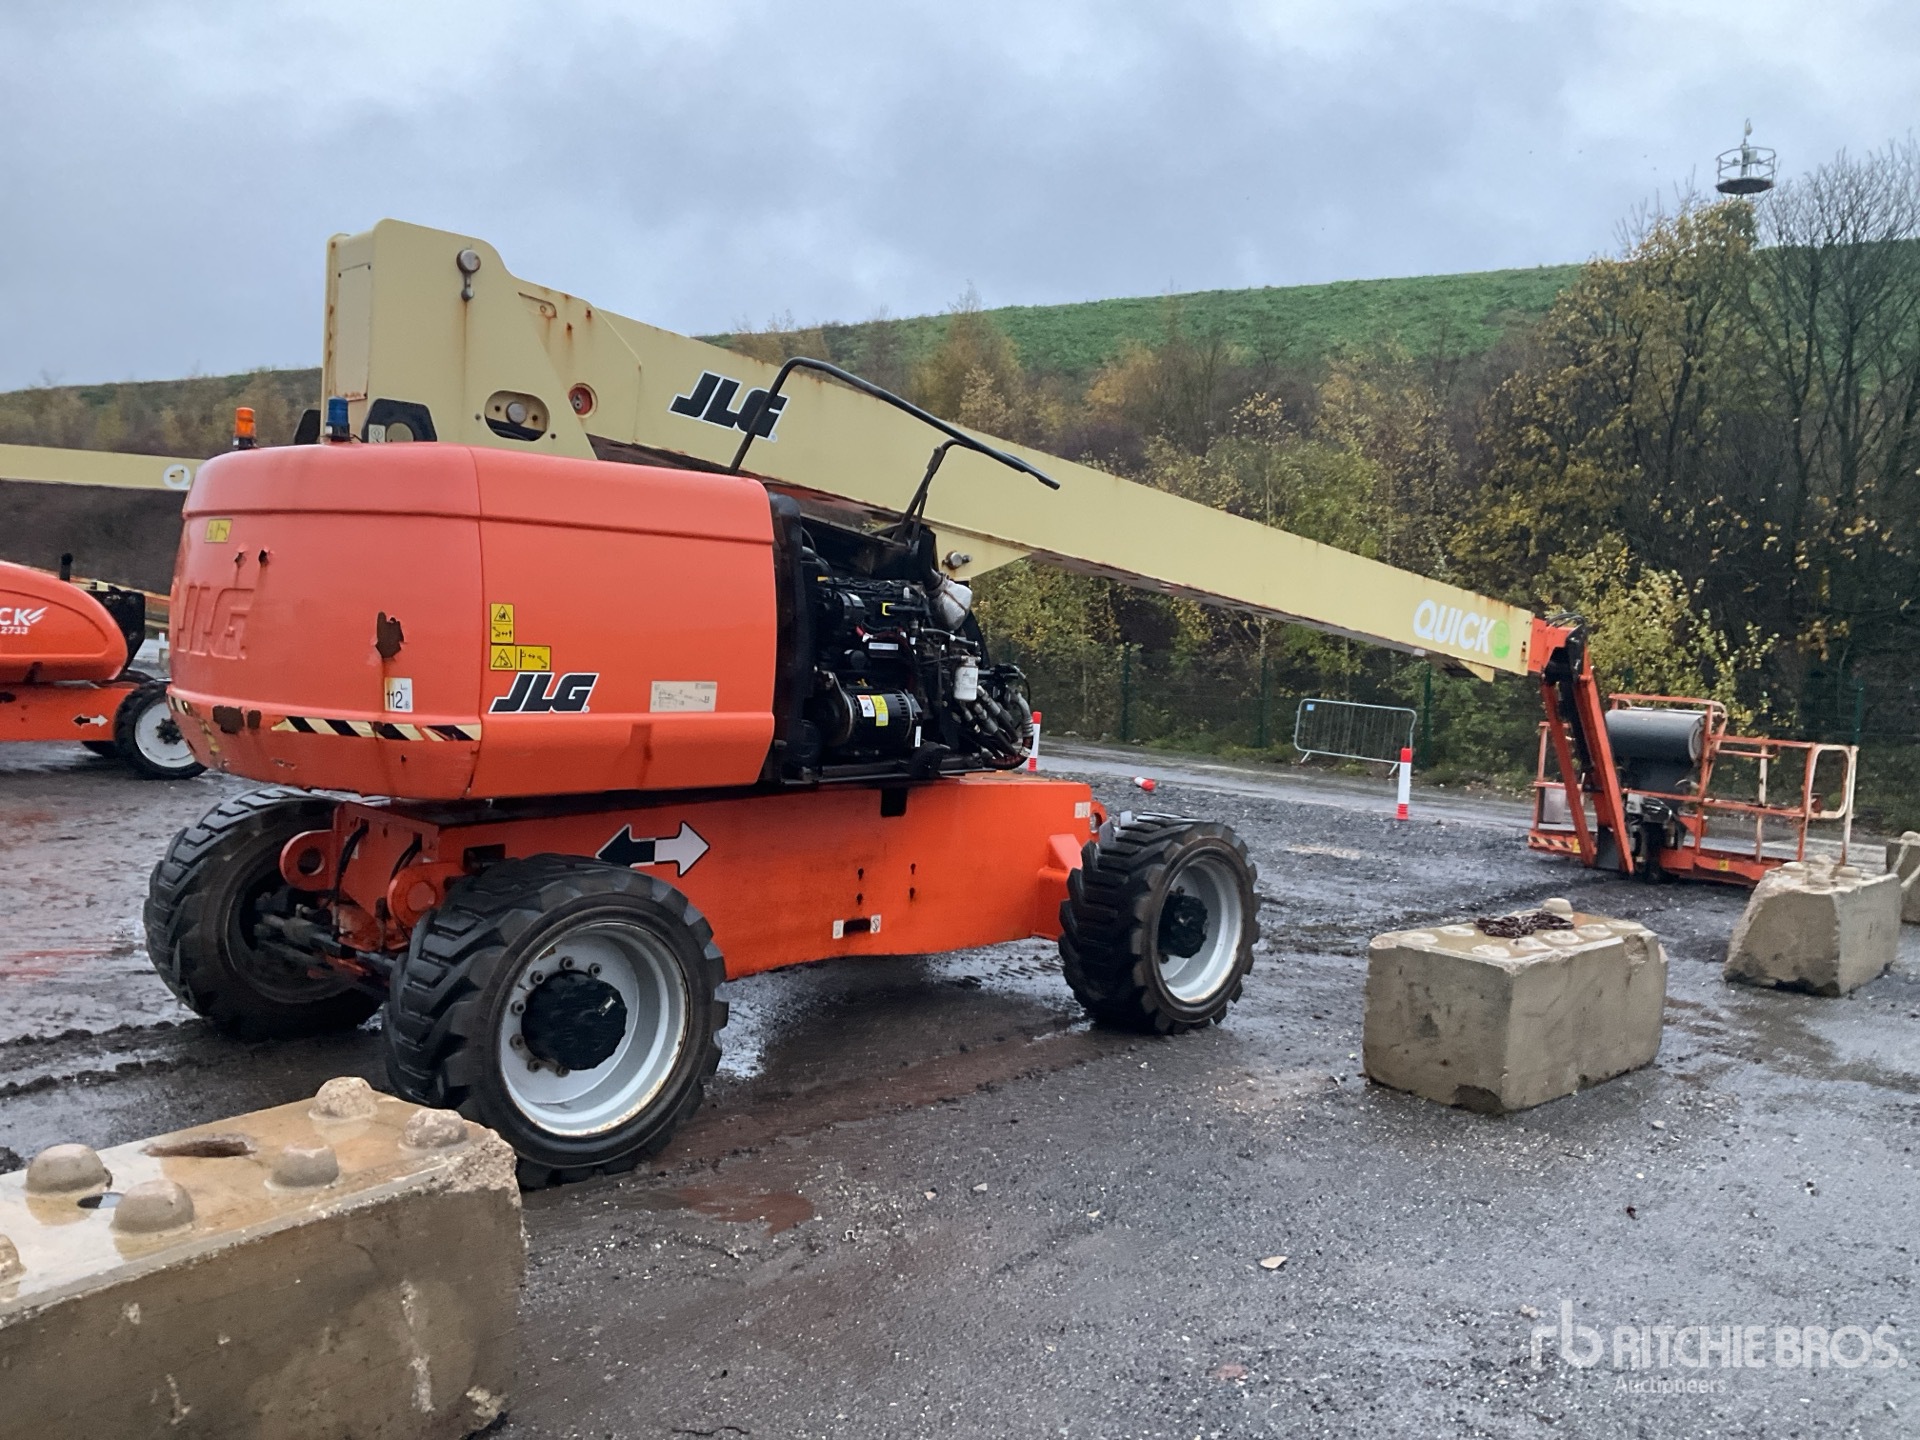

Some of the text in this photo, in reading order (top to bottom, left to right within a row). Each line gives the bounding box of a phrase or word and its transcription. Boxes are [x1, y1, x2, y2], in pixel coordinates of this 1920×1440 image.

[668, 370, 789, 442] JLG
[1413, 598, 1496, 654] QUICK
[386, 690, 403, 709] 112
[488, 672, 599, 714] JLG
